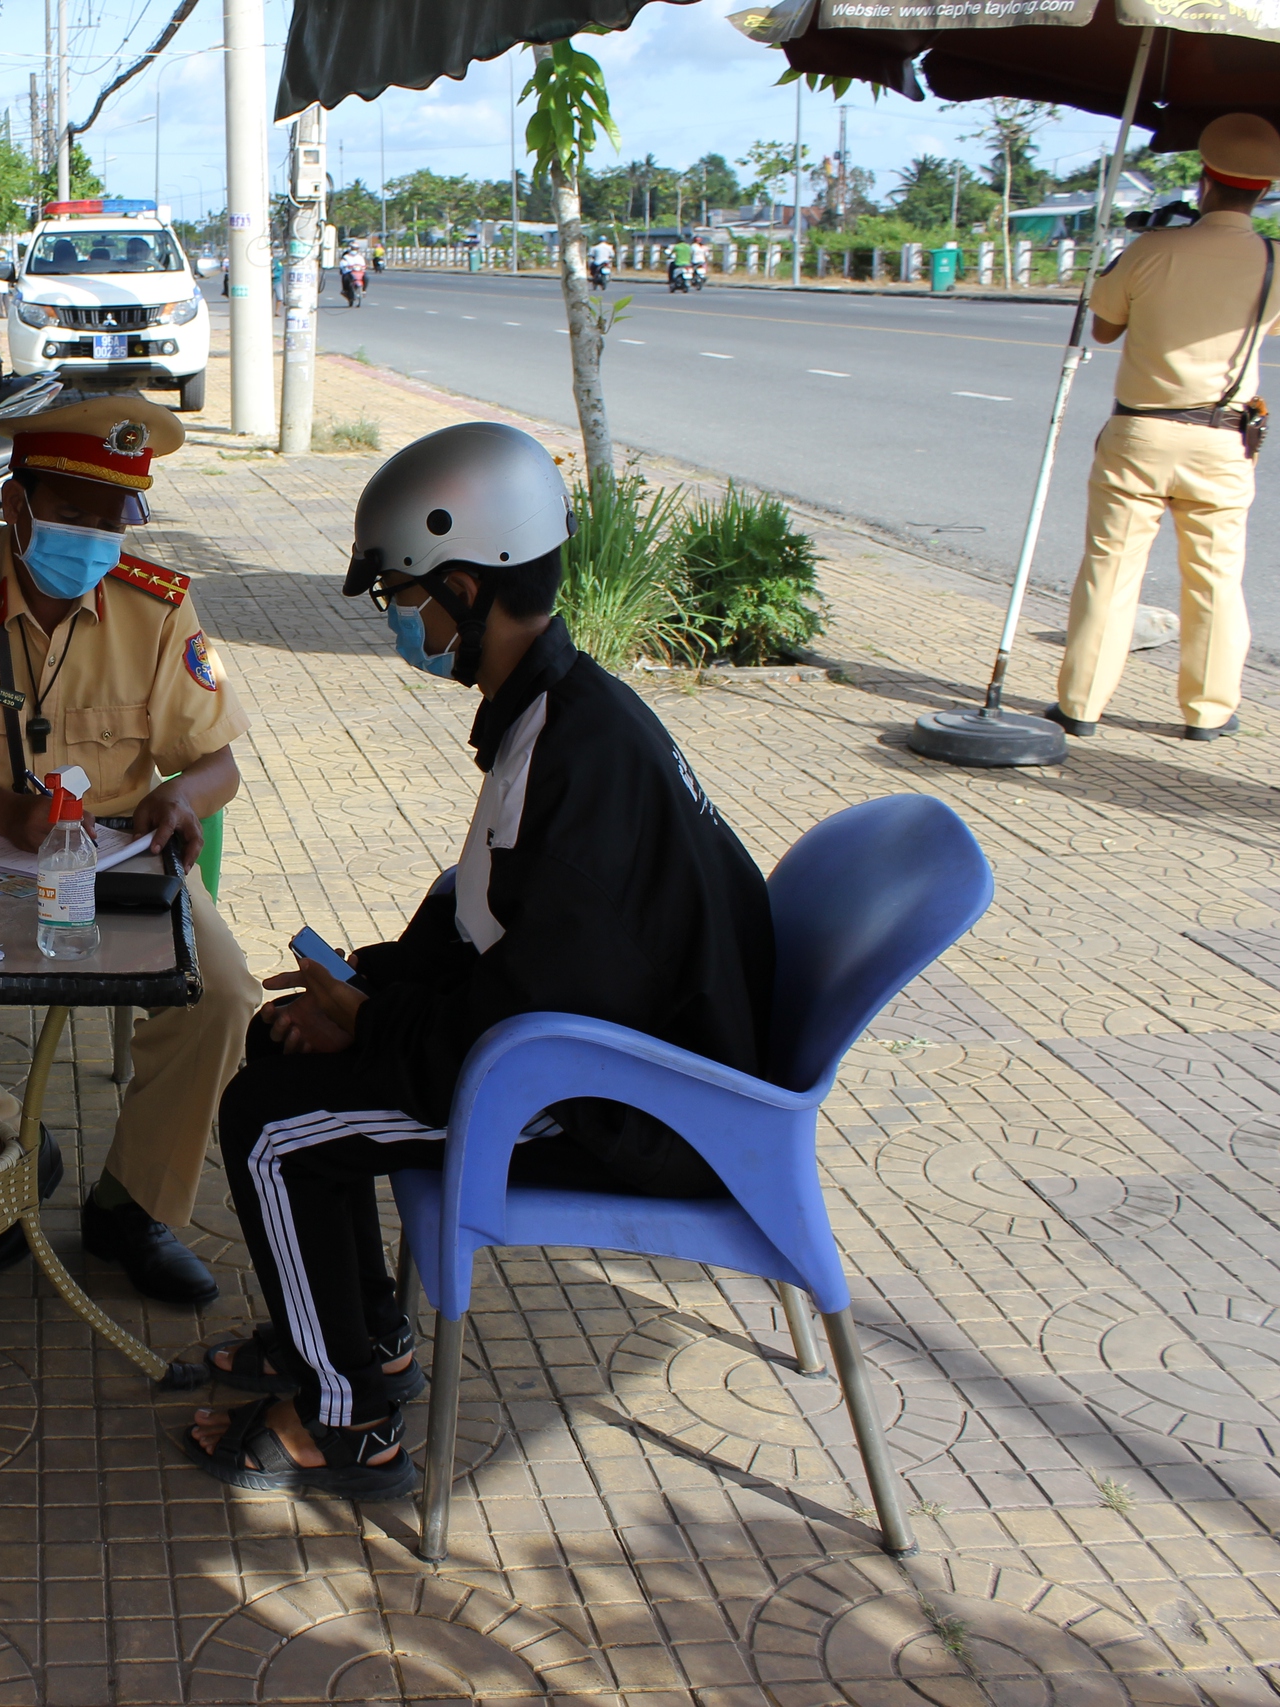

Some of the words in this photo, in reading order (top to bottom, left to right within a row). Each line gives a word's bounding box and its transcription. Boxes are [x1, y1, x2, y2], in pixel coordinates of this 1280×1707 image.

[832, 3, 895, 17] Website:
[899, 4, 980, 19] www.caphe
[984, 0, 1075, 18] taylong.com
[1181, 12, 1226, 20] COFFEE
[101, 336, 120, 347] 95A
[46, 889, 54, 897] VP
